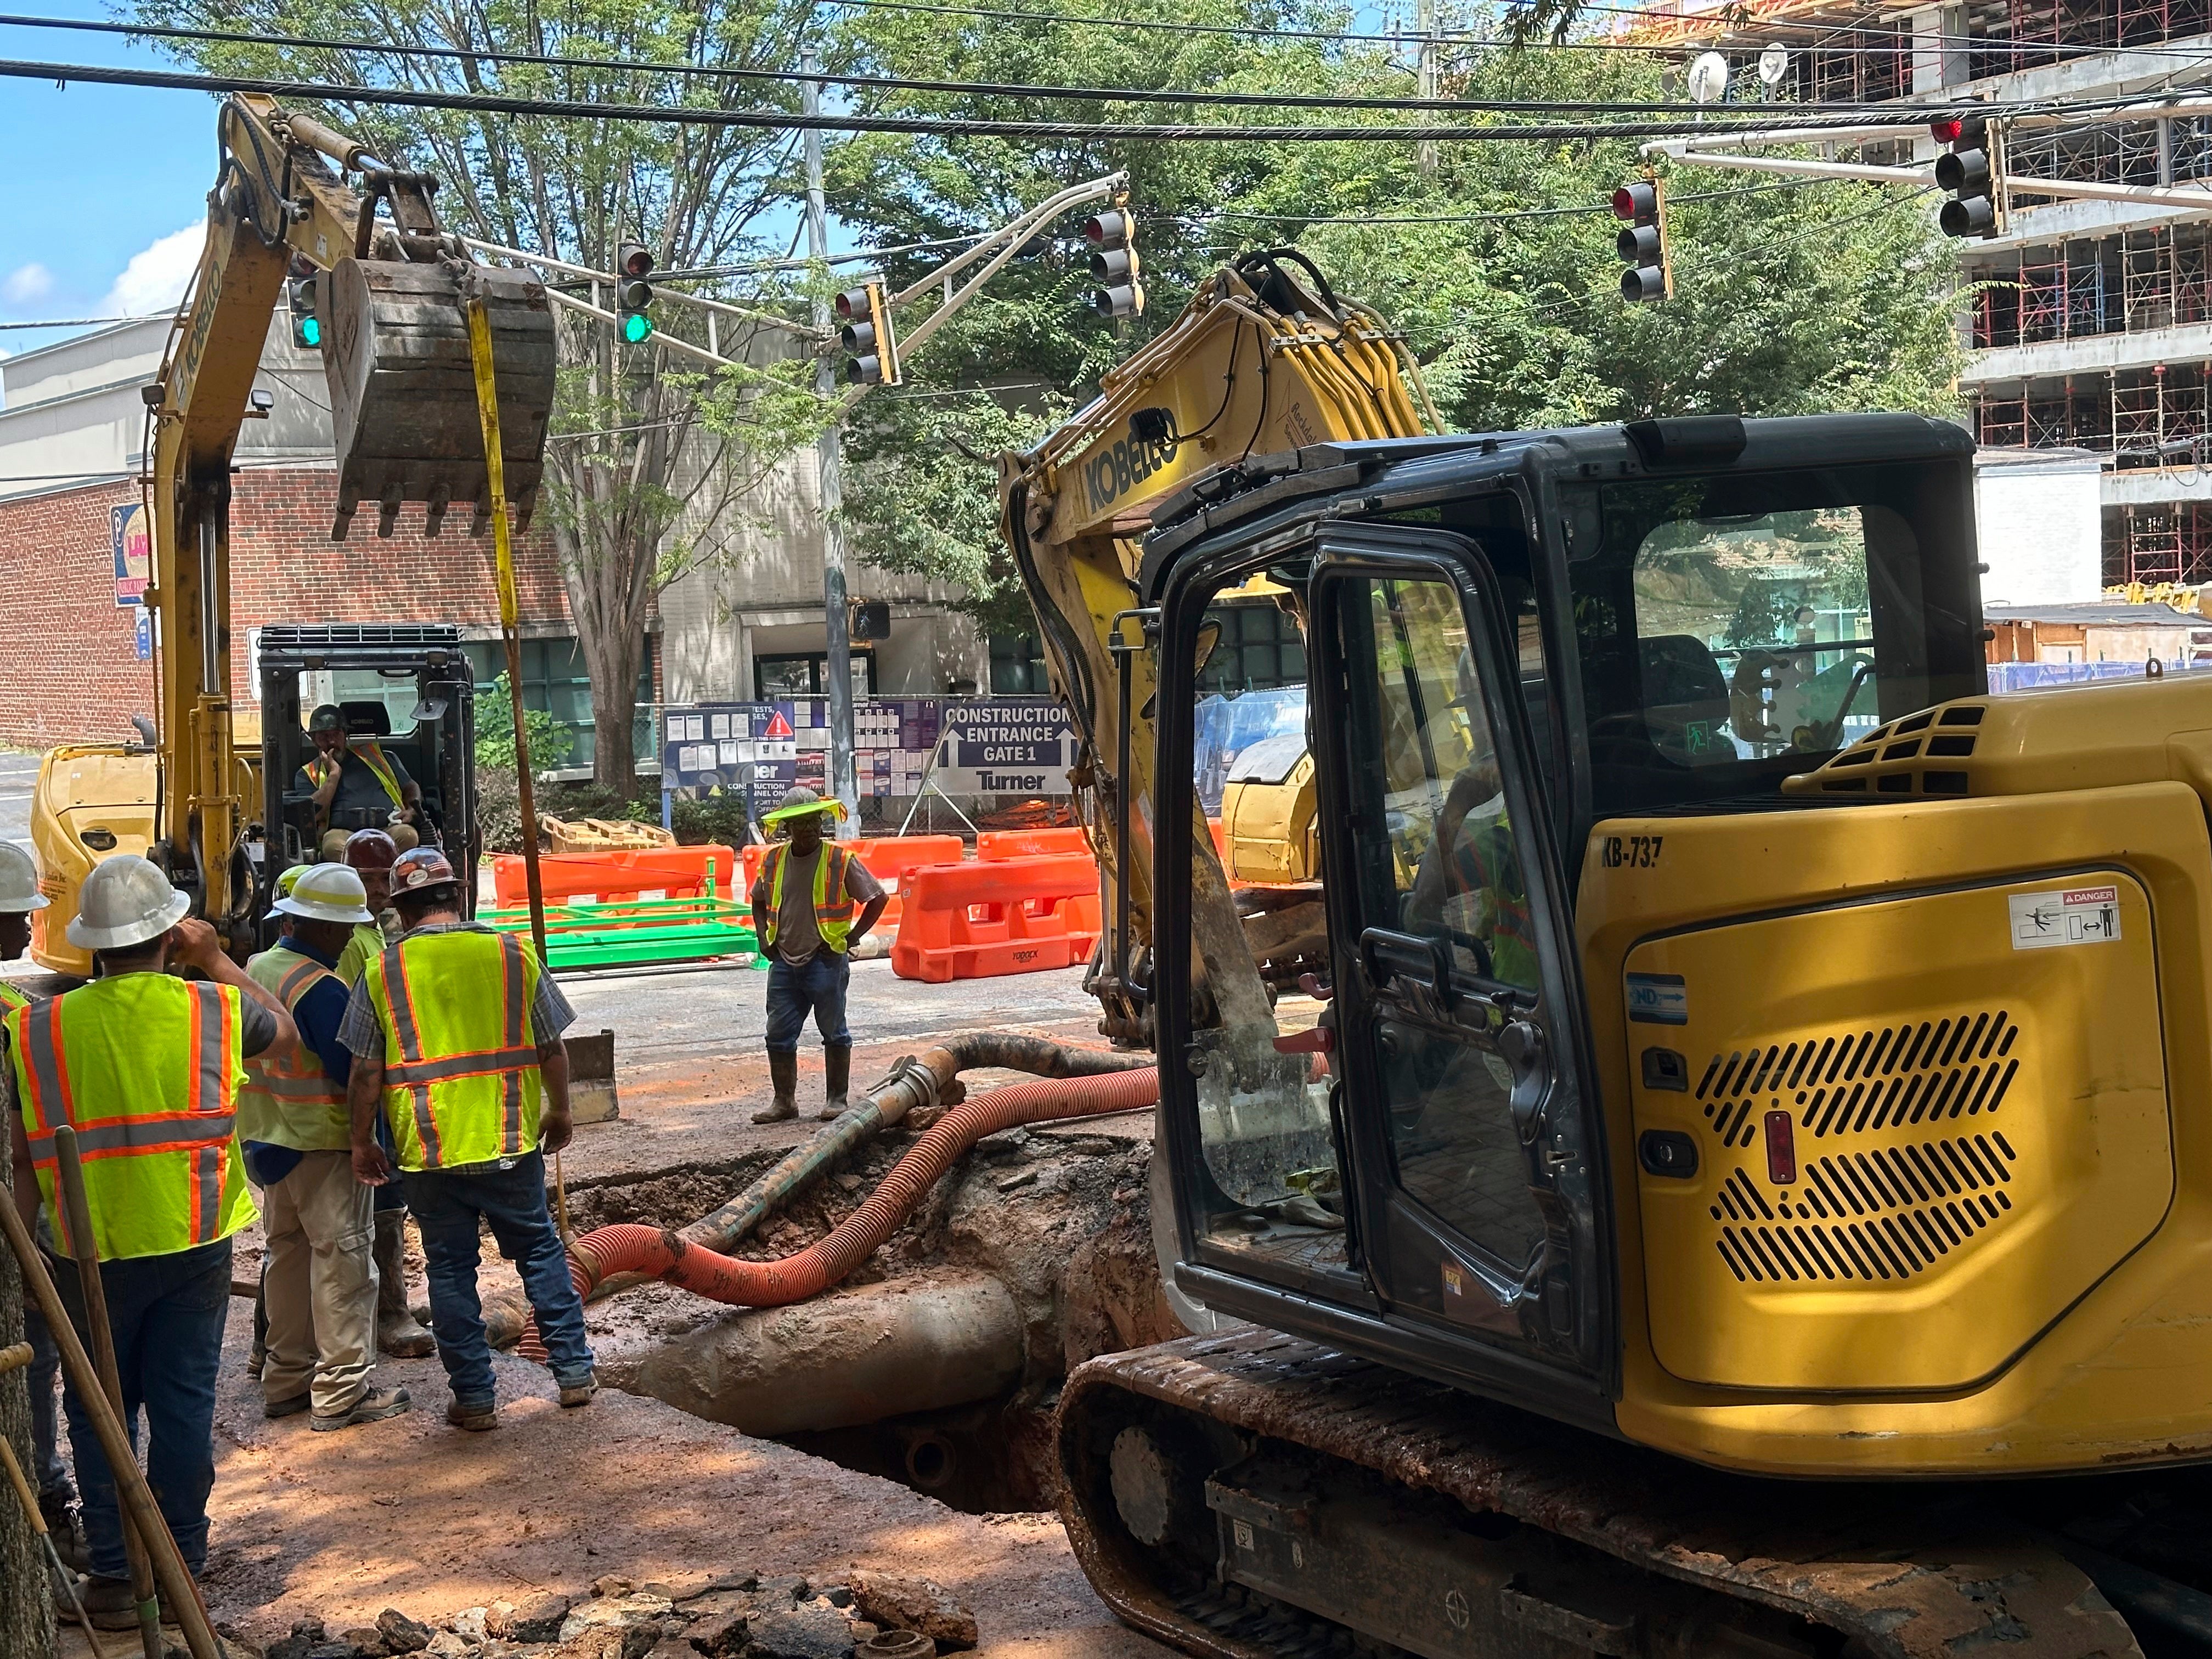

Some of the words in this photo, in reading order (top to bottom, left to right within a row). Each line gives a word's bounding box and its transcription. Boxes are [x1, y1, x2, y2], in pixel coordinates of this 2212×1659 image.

[1291, 402, 1317, 445] Rockdal
[115, 517, 121, 541] P
[945, 708, 1071, 723] CONSTRUCTION
[967, 727, 1053, 742] ENTRANCE
[984, 747, 1024, 761] GATE
[1028, 747, 1036, 761] 1
[976, 771, 1046, 790] Turner
[1601, 836, 1663, 867] KB-737
[2074, 891, 2113, 902] DANGER
